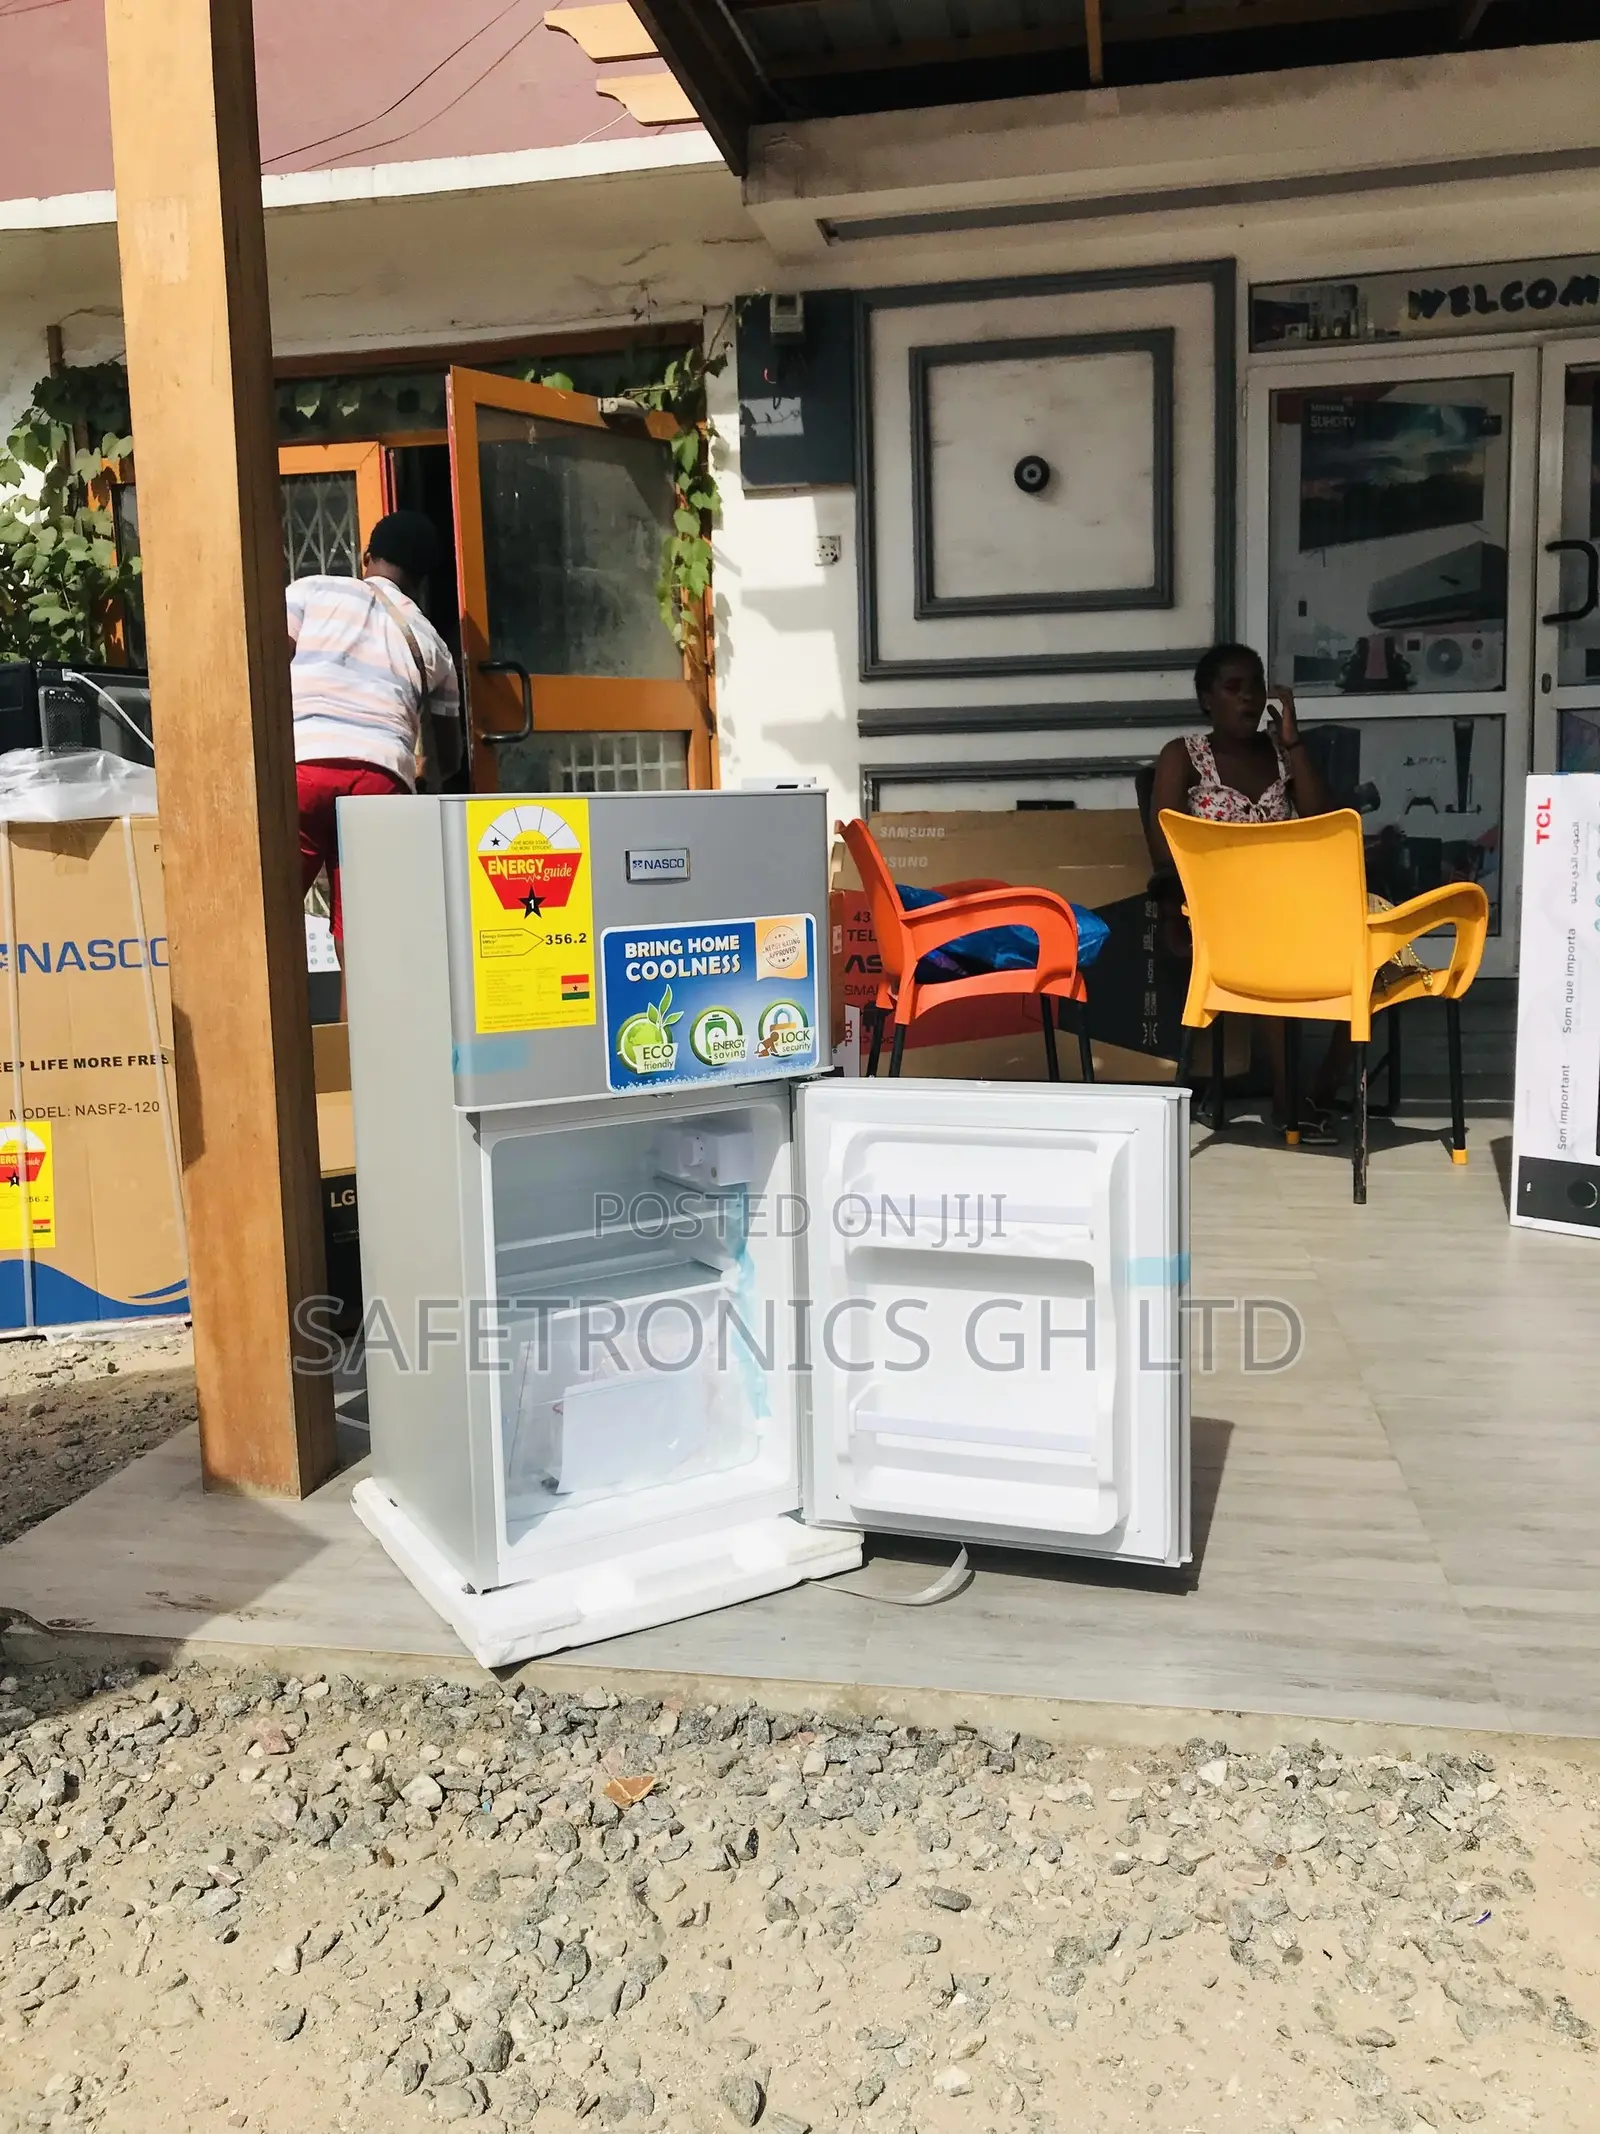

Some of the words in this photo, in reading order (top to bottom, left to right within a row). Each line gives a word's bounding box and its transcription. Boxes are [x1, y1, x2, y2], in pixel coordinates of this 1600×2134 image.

[1536, 798, 1551, 845] TCL
[880, 826, 946, 838] SAMSUNG
[487, 856, 544, 880] ENERGY
[542, 862, 572, 882] guide
[644, 858, 685, 869] NASCO
[545, 932, 587, 945] 356.2
[624, 937, 683, 960] BRING
[687, 934, 741, 954] HOME
[1565, 927, 1577, 977] importa
[625, 954, 741, 982] COOLNESS
[1565, 981, 1574, 1003] que
[1562, 1007, 1572, 1034] Som
[781, 1030, 811, 1044] LOCK
[844, 1020, 853, 1047] TCL
[643, 1045, 674, 1060] ECO
[713, 1039, 746, 1052] ENERGY
[713, 1050, 746, 1060] saving
[782, 1042, 811, 1053] security
[30, 1059, 69, 1071] LIFE
[73, 1056, 123, 1070] MORE
[643, 1059, 674, 1071] friendly
[1559, 1065, 1571, 1124] important
[9, 1106, 71, 1121] MODEL:
[75, 1100, 160, 1117] NASF2-120
[1557, 1127, 1567, 1151] Son
[330, 1189, 355, 1208] LG
